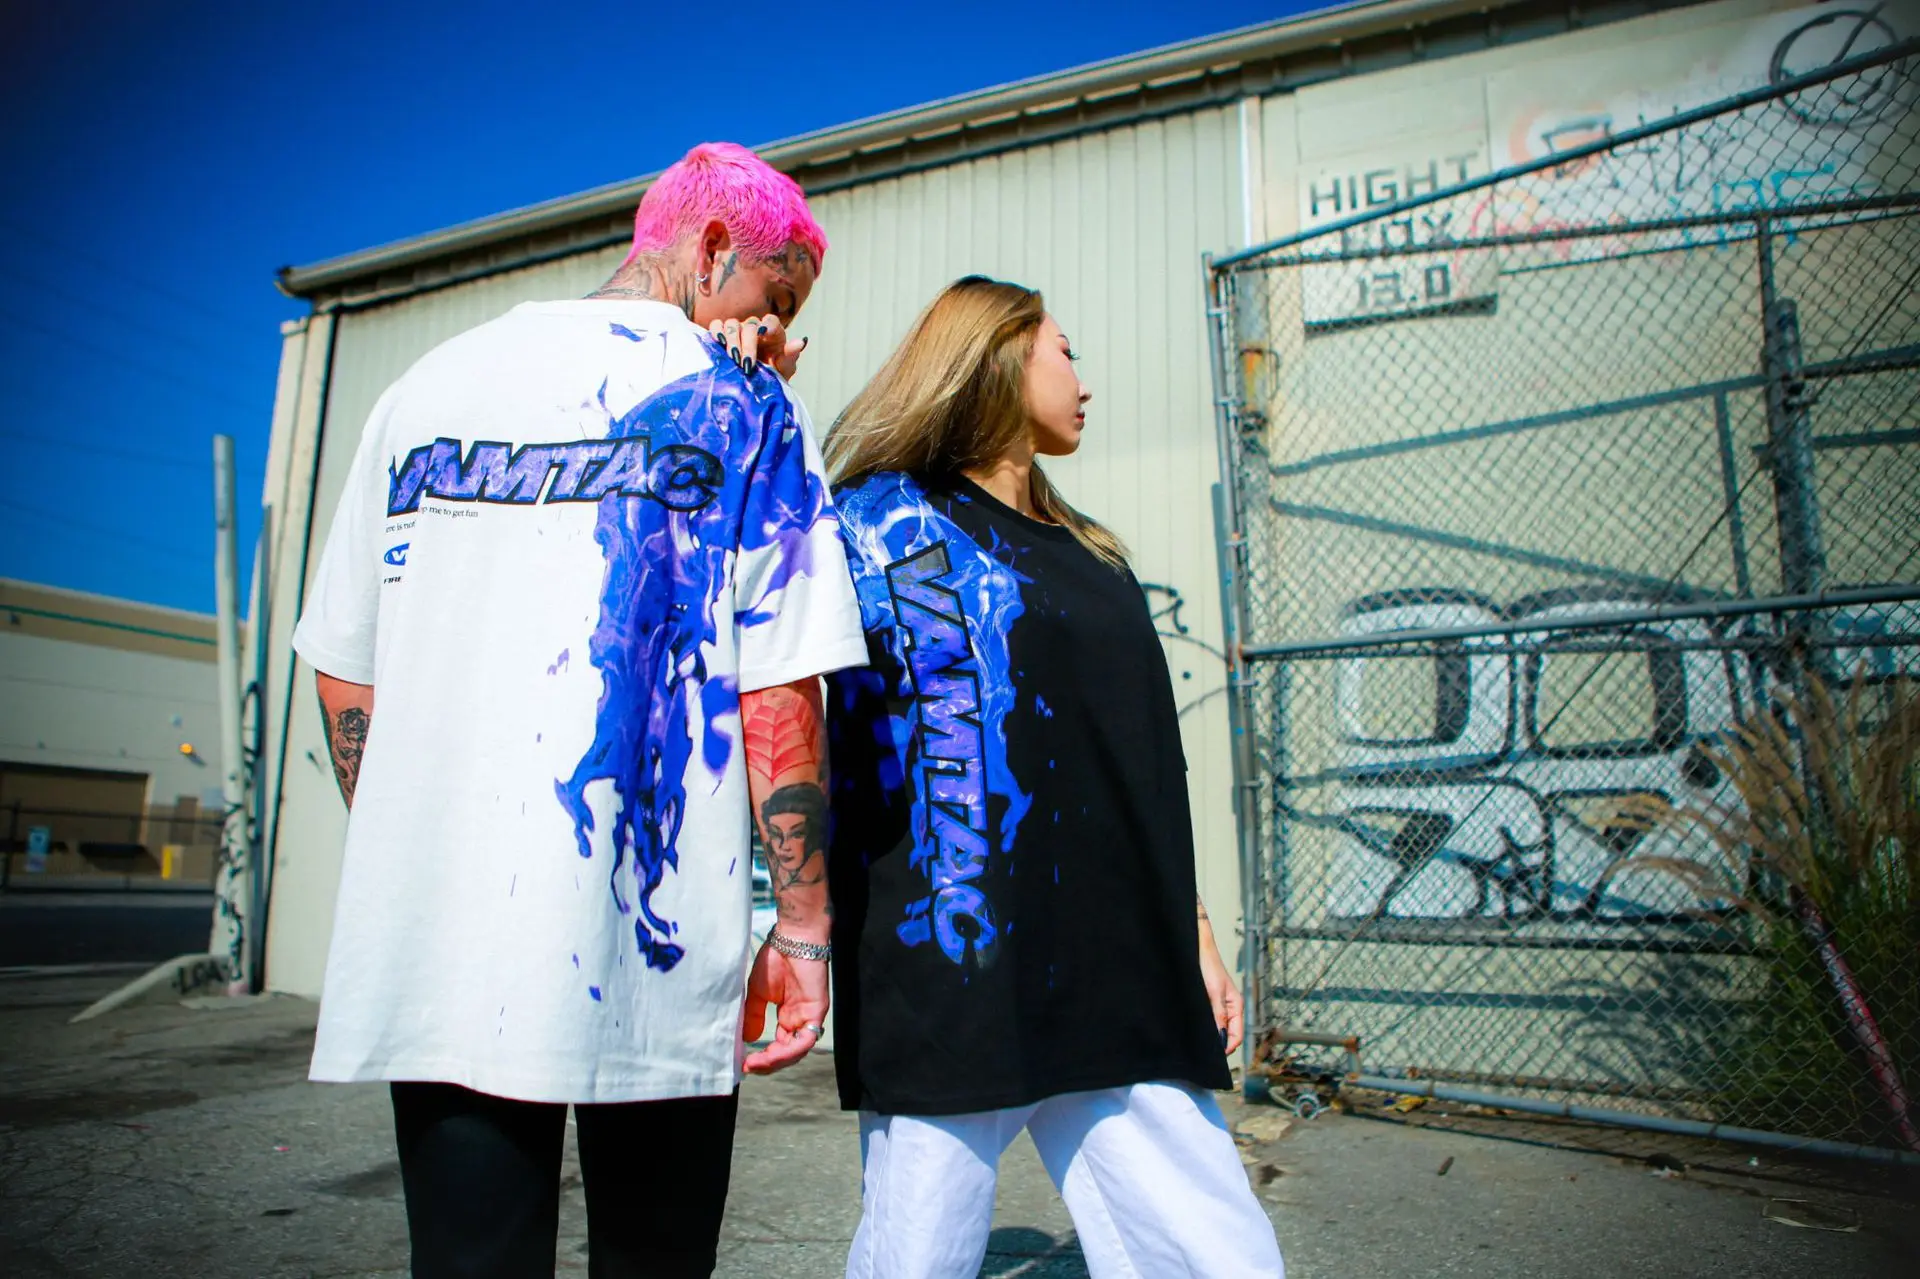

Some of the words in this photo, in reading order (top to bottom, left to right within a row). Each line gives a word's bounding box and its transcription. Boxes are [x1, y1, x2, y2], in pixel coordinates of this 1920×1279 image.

[1310, 152, 1479, 216] HIGHT
[396, 523, 402, 531] is
[429, 506, 442, 515] me
[443, 507, 451, 515] to
[452, 509, 464, 518] get
[465, 509, 478, 518] fun
[884, 539, 998, 968] VAMTAC
